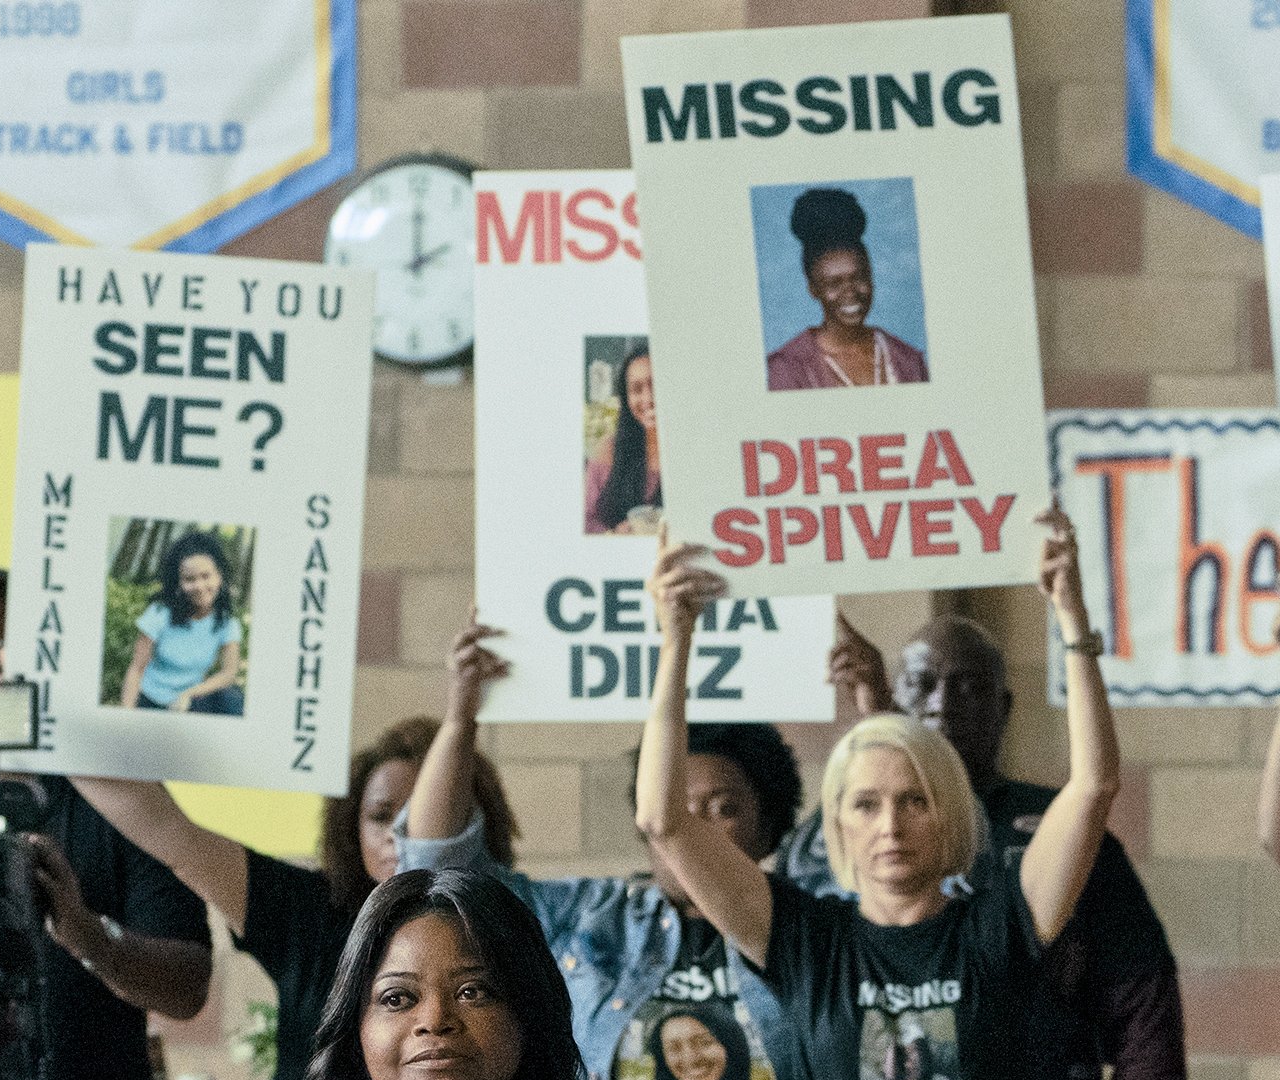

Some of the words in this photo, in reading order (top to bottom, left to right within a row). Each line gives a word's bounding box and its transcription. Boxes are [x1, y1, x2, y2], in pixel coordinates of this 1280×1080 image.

[66, 68, 166, 103] GIRLS
[641, 68, 1003, 143] MISSING
[145, 120, 245, 156] FIELD
[58, 266, 206, 312] HAVE
[240, 278, 345, 321] YOU
[92, 319, 287, 384] SEEN
[95, 391, 285, 473] ME?
[741, 429, 975, 499] DREA
[710, 494, 1018, 569] SPIVEY
[36, 471, 73, 752] MELANIE
[291, 493, 333, 773] SANCHEZ
[544, 576, 779, 632] CEIA
